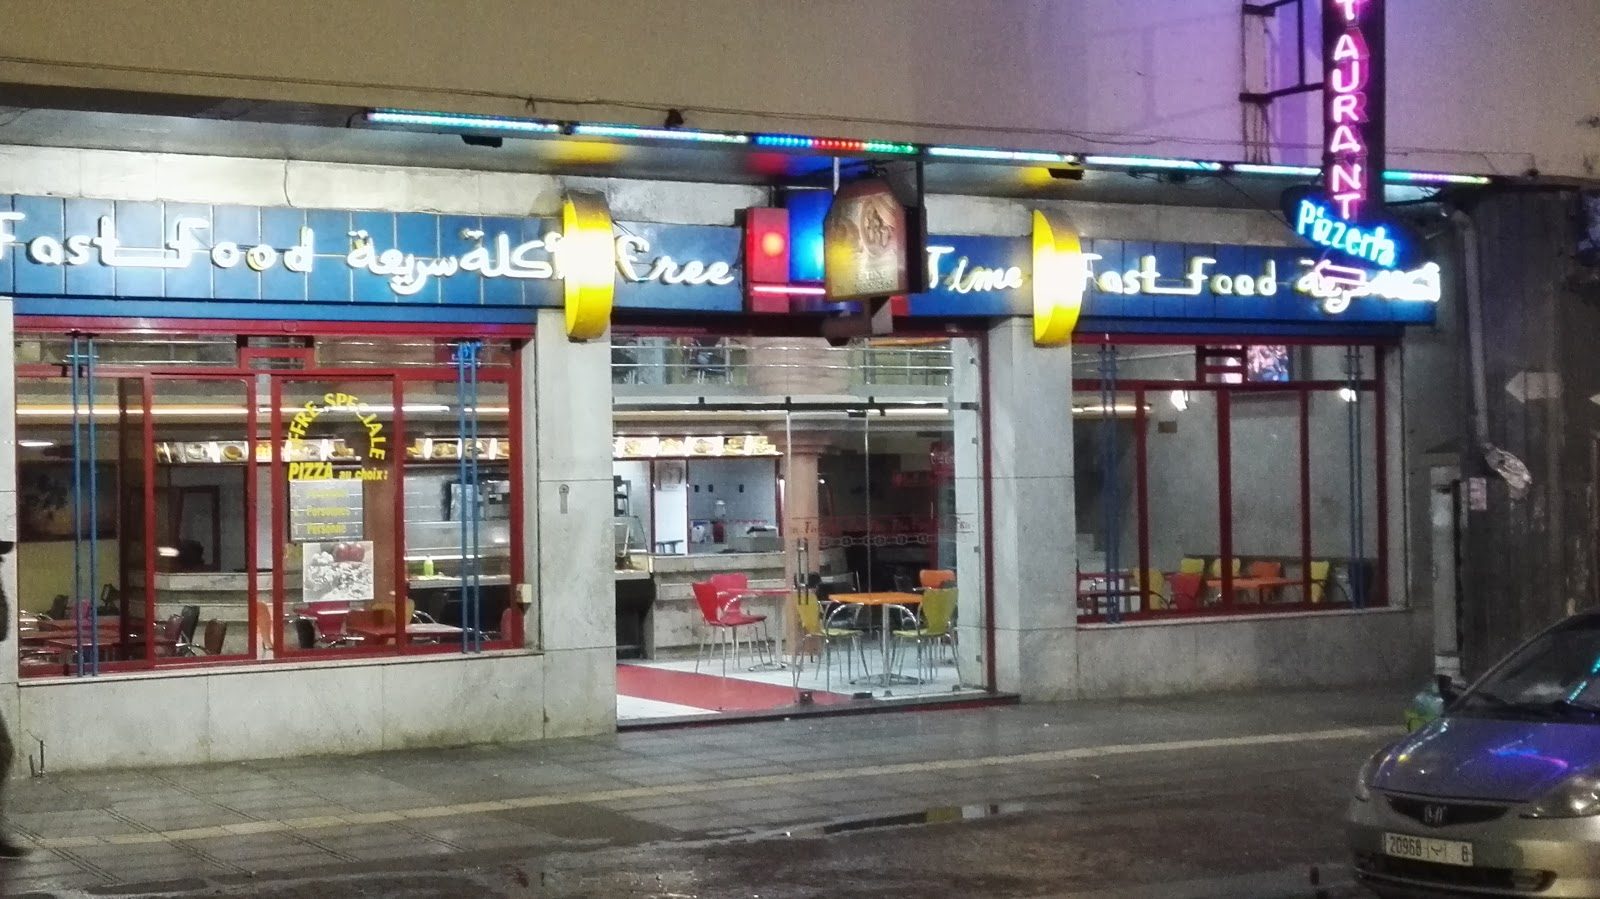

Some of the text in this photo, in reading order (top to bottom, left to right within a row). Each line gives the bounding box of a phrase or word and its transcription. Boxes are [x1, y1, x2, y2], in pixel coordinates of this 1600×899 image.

[1296, 199, 1396, 268] Pizzeria
[347, 230, 459, 295] سريعة
[926, 246, 1023, 294] Time
[1081, 253, 1175, 295] Fast
[287, 401, 321, 452] FFRE
[288, 461, 334, 481] PIZZA
